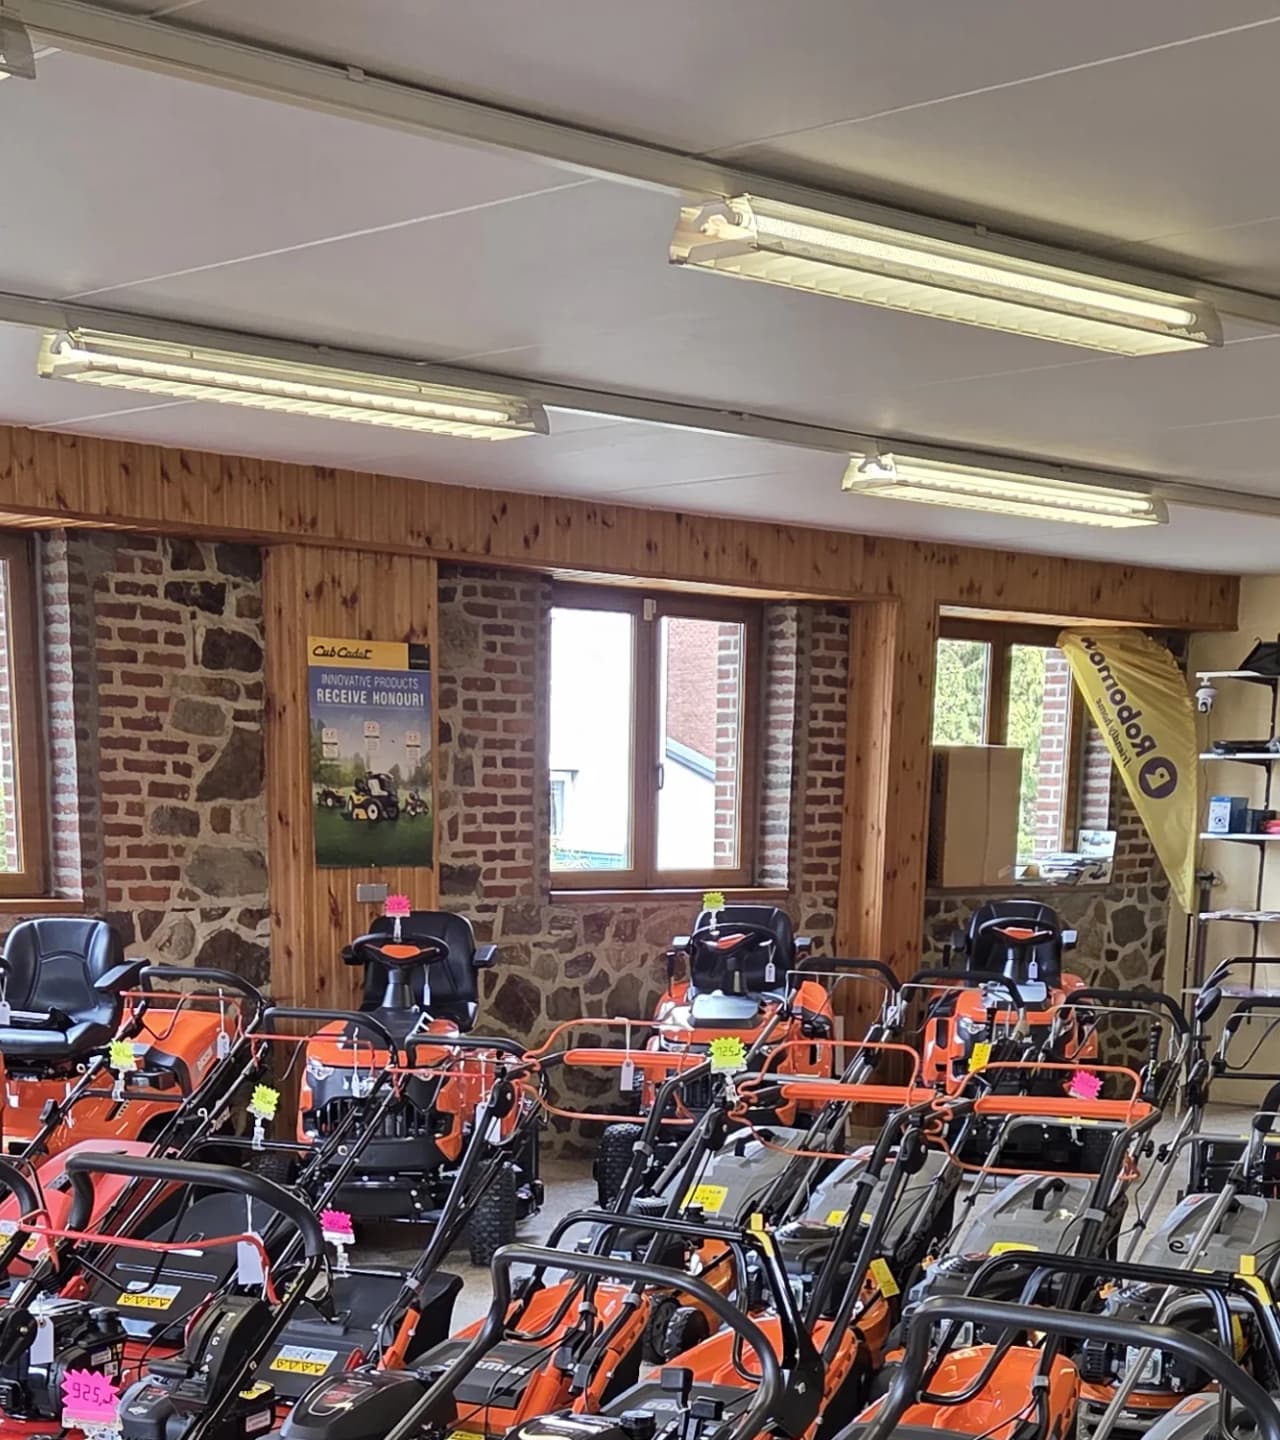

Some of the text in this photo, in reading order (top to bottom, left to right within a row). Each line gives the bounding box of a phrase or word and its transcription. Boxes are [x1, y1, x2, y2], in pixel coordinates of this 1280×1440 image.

[312, 645, 336, 658] Cub
[321, 673, 419, 690] INNOVATIVE PRODUCTS
[316, 688, 368, 705] RECEIVE
